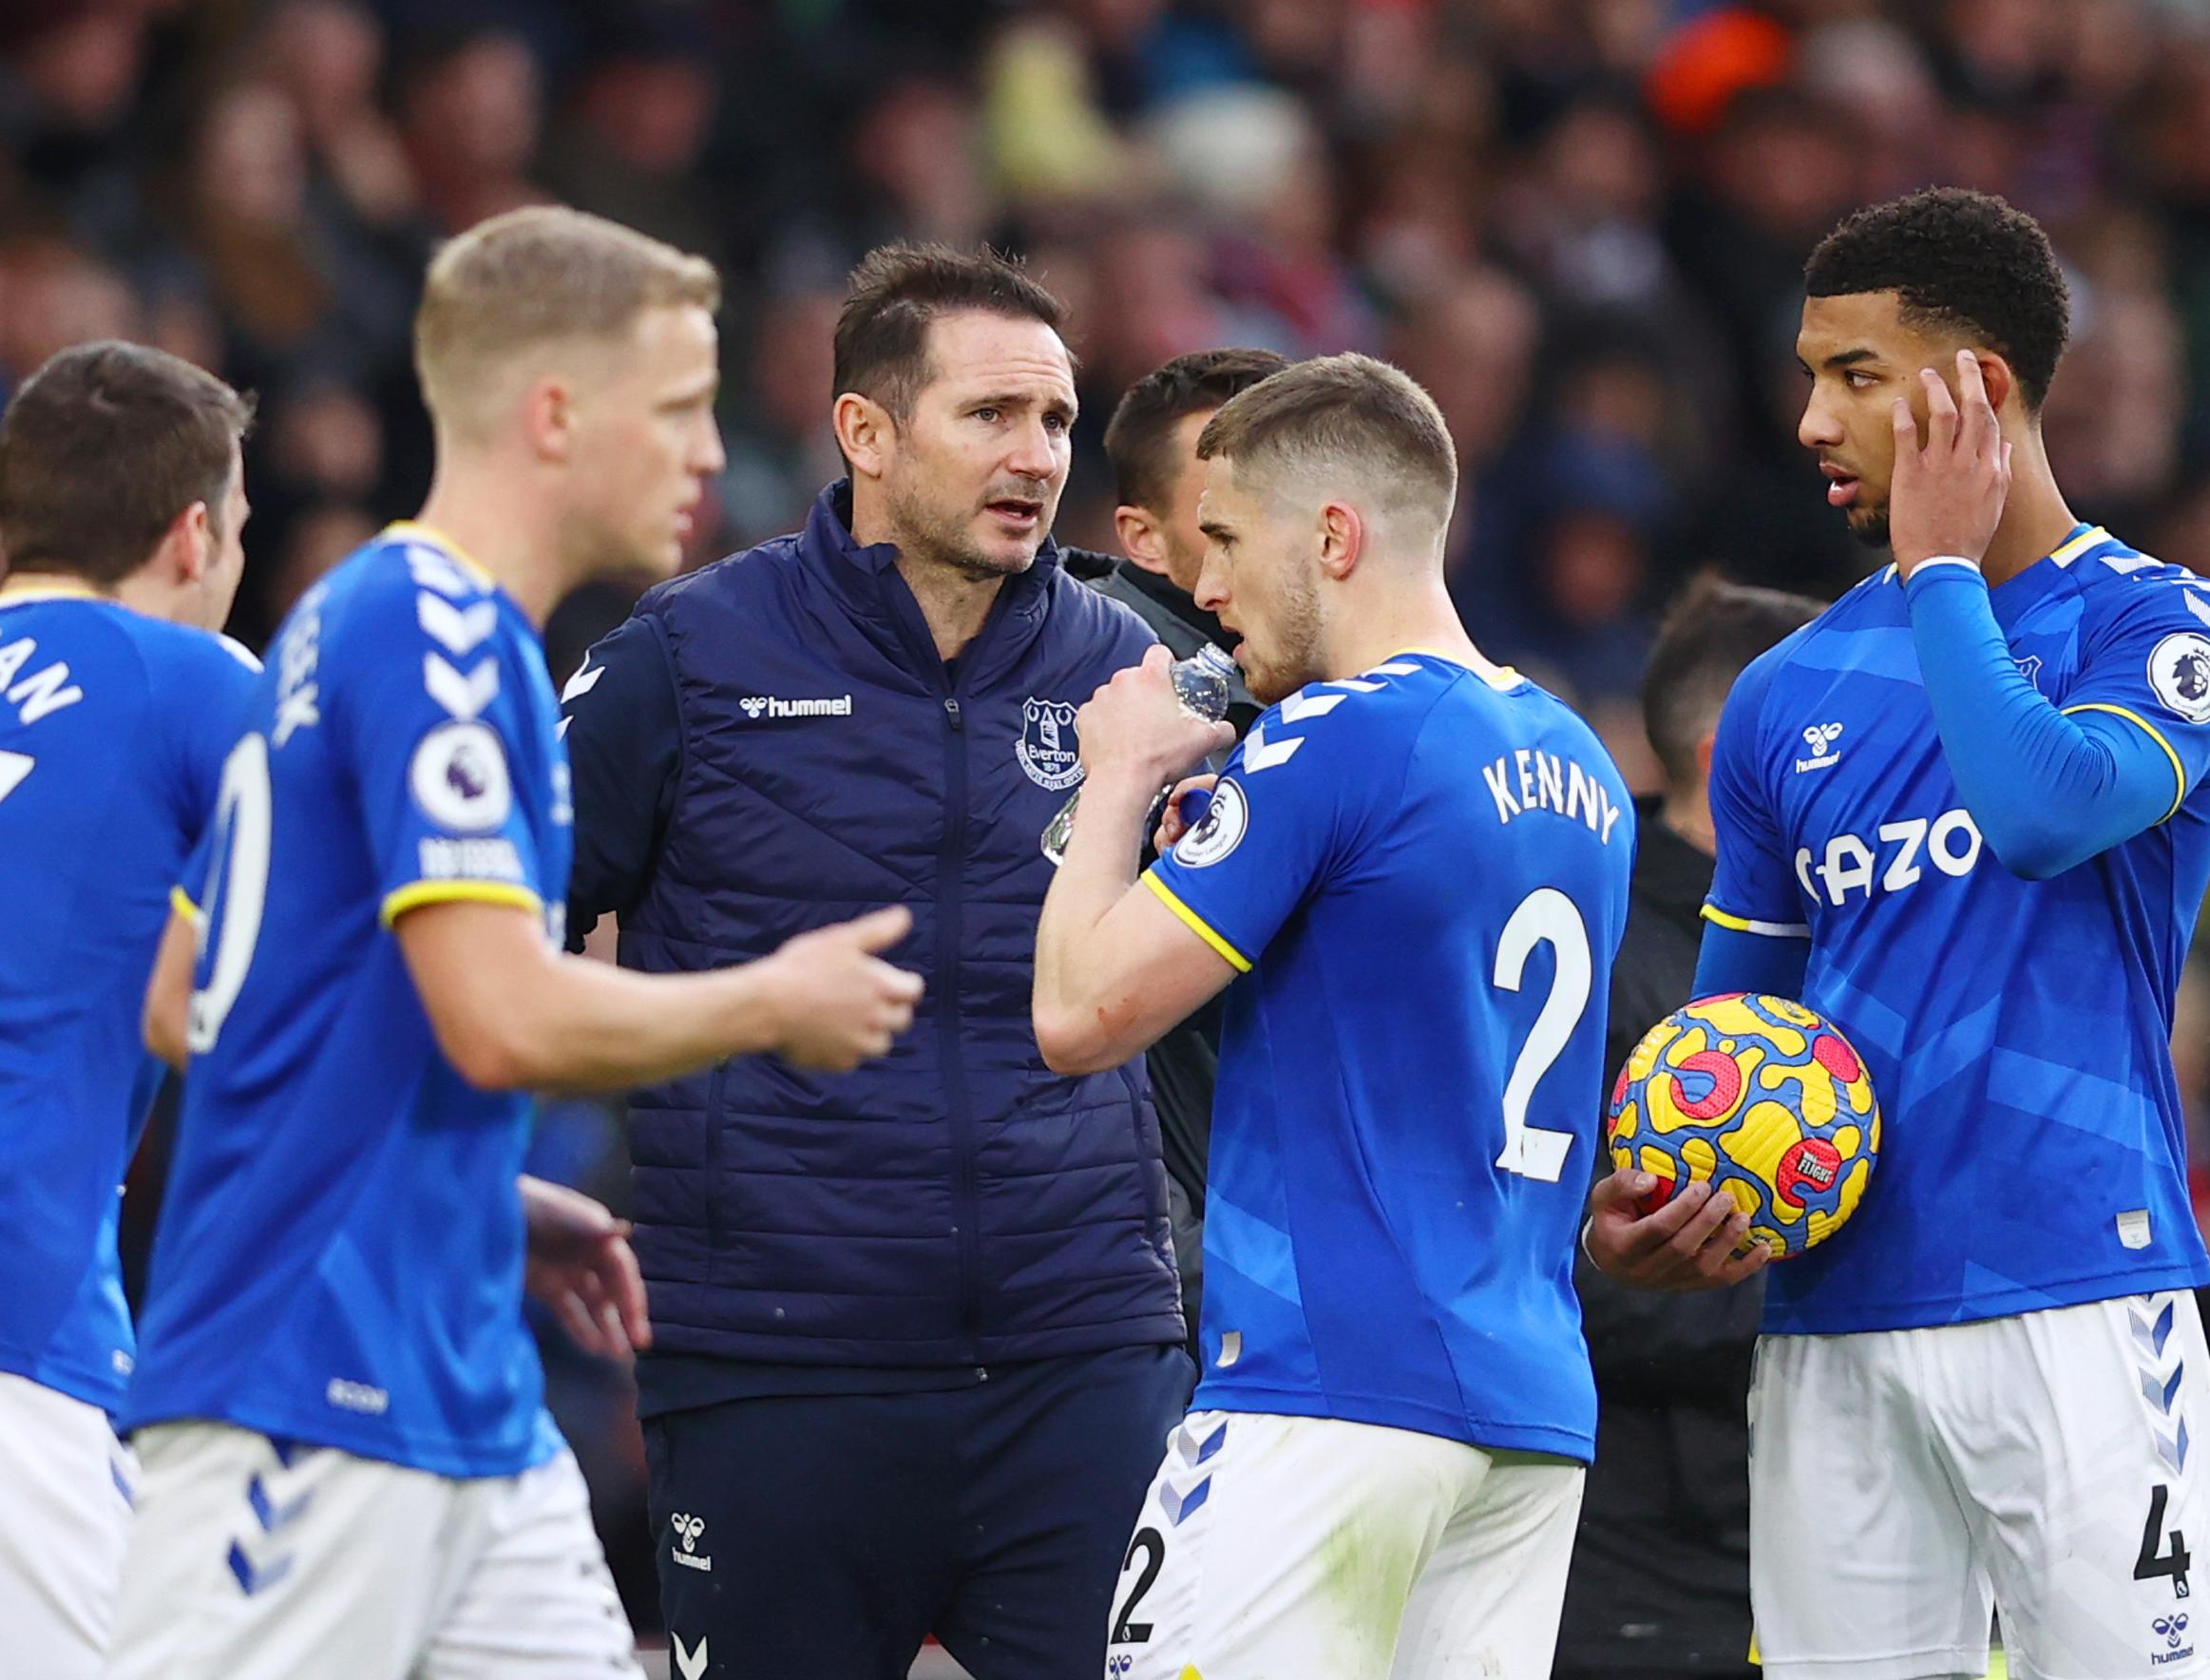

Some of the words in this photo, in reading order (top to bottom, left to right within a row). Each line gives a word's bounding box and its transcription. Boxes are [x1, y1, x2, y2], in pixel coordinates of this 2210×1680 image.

[768, 694, 852, 717] hummel
[1028, 744, 1076, 762] Everton
[1482, 749, 1620, 847] KENNY
[1493, 887, 1592, 1183] 2
[672, 1546, 712, 1572] hummel
[2134, 1484, 2191, 1599] 4
[1110, 1527, 1165, 1644] 2
[2151, 1642, 2194, 1665] hummel
